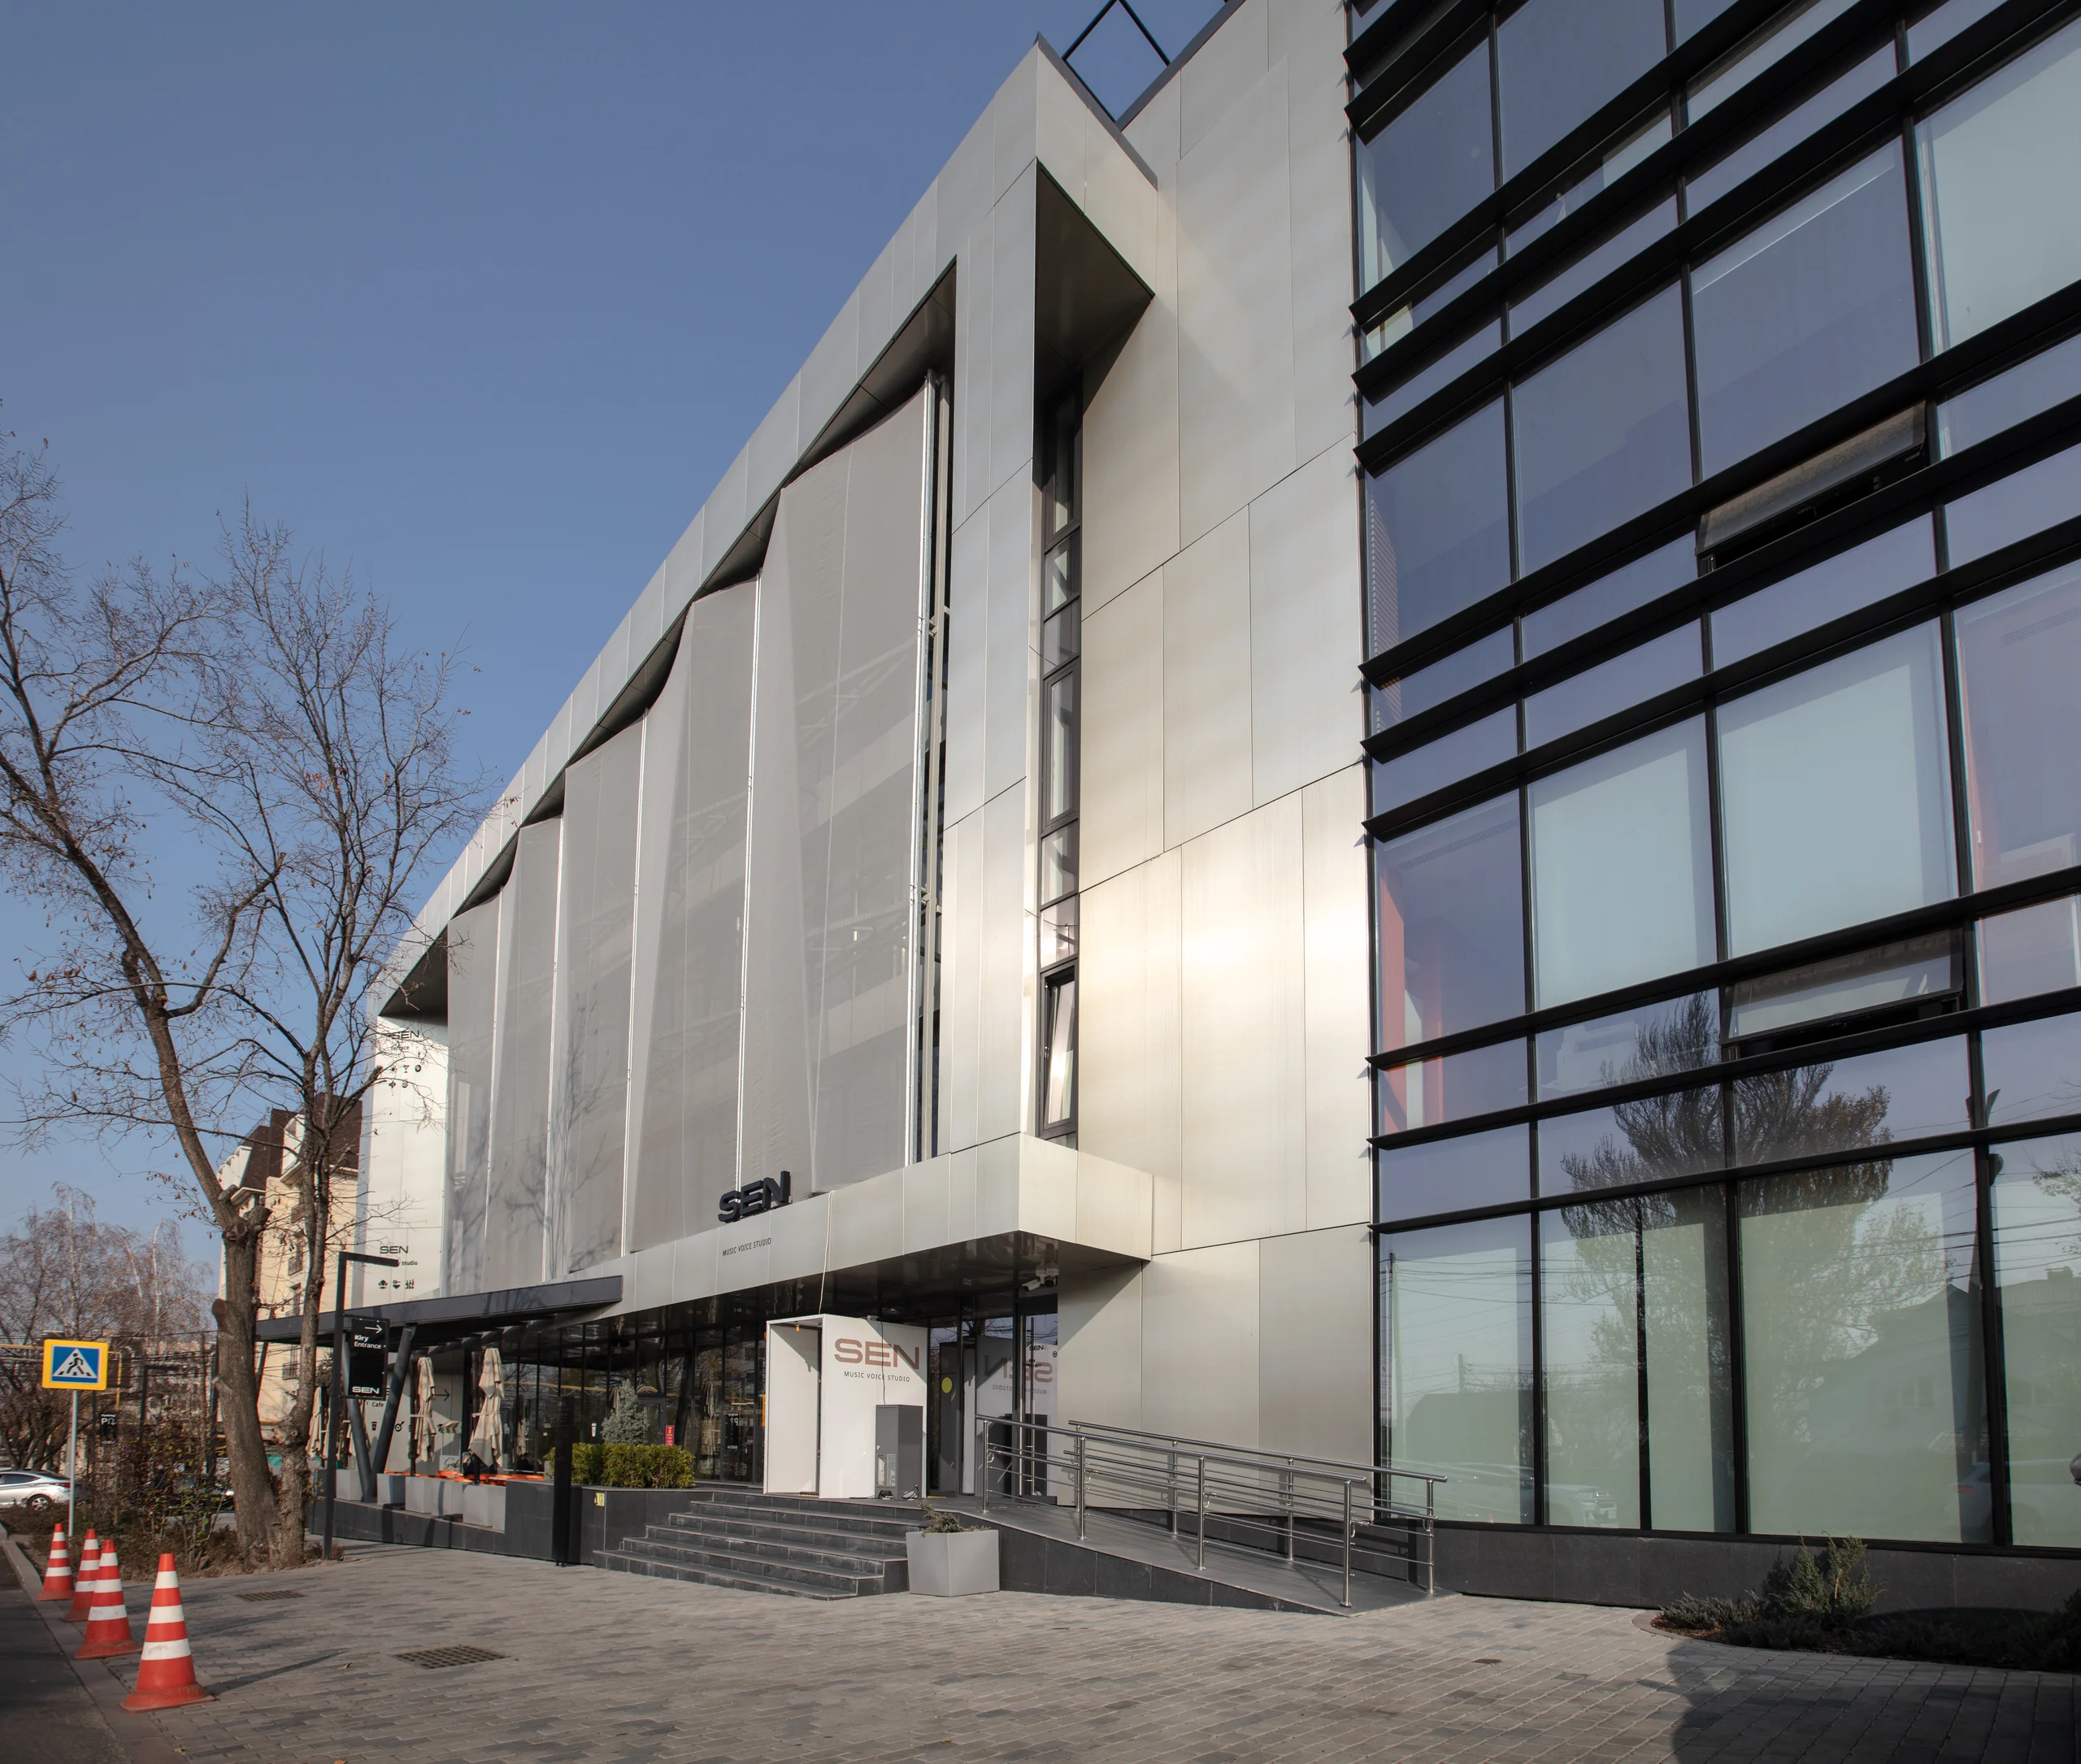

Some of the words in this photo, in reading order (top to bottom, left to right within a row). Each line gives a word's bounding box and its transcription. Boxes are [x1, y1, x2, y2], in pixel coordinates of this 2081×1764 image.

[718, 1171, 791, 1223] SEN
[380, 1245, 409, 1254] SEN
[723, 1247, 736, 1256] MUSIC
[738, 1243, 752, 1252] VOICE
[754, 1238, 771, 1249] STUDIO
[354, 1341, 382, 1349] Entrance
[834, 1338, 919, 1370] SEN
[888, 1375, 910, 1383] STUDIO
[352, 1386, 380, 1394] SEN
